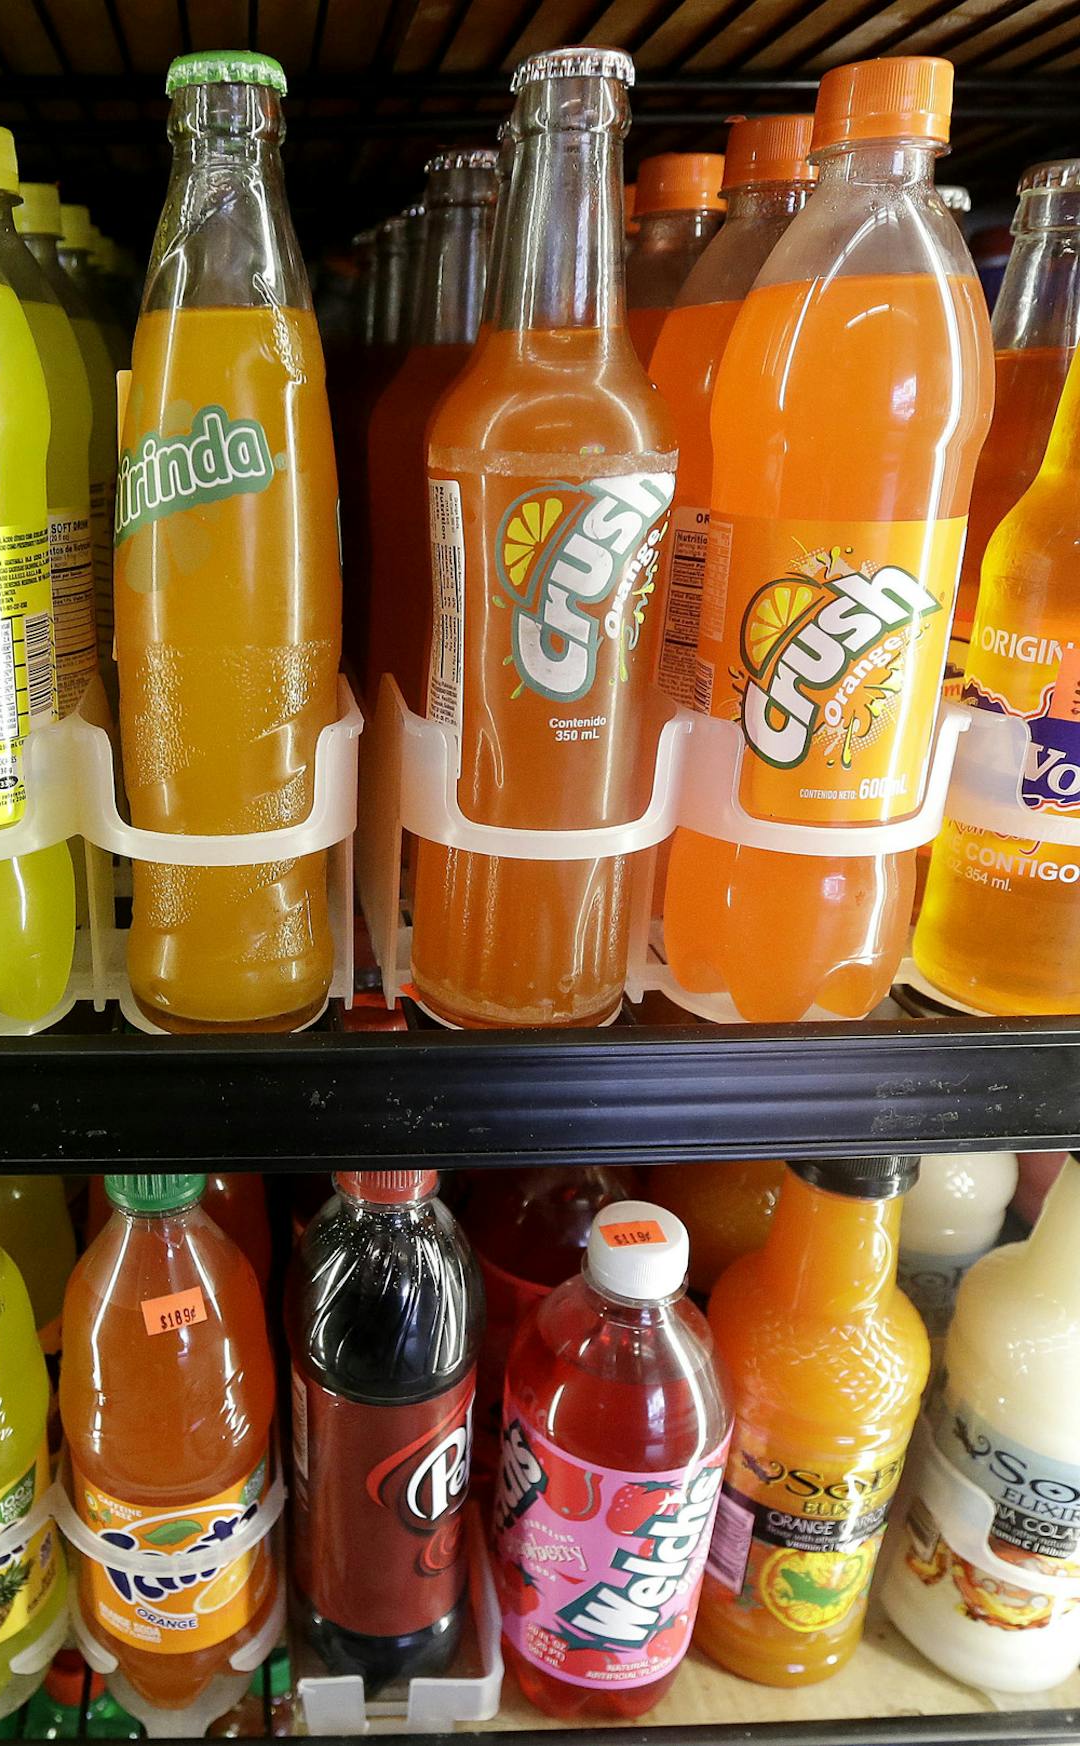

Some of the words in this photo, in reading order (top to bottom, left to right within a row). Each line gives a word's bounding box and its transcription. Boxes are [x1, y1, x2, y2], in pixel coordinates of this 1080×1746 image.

[51, 522, 72, 534] SOFT
[677, 532, 708, 545] Nutritio
[517, 471, 677, 695] Crush
[980, 625, 1075, 666] ORIGIN
[744, 565, 940, 768] Crush
[824, 632, 904, 723] Orange
[548, 715, 608, 729] Contenido
[554, 730, 579, 741] 350
[580, 729, 601, 741] mL
[799, 788, 838, 800] CONTENIDO
[964, 841, 1080, 884] CONTIGO
[964, 865, 989, 885] 354
[991, 876, 1012, 892] ml.
[802, 1499, 871, 1517] ELIXR
[768, 1510, 837, 1536] ORANGE
[136, 1608, 198, 1629] ORANGE
[606, 1660, 649, 1672] NATURAL
